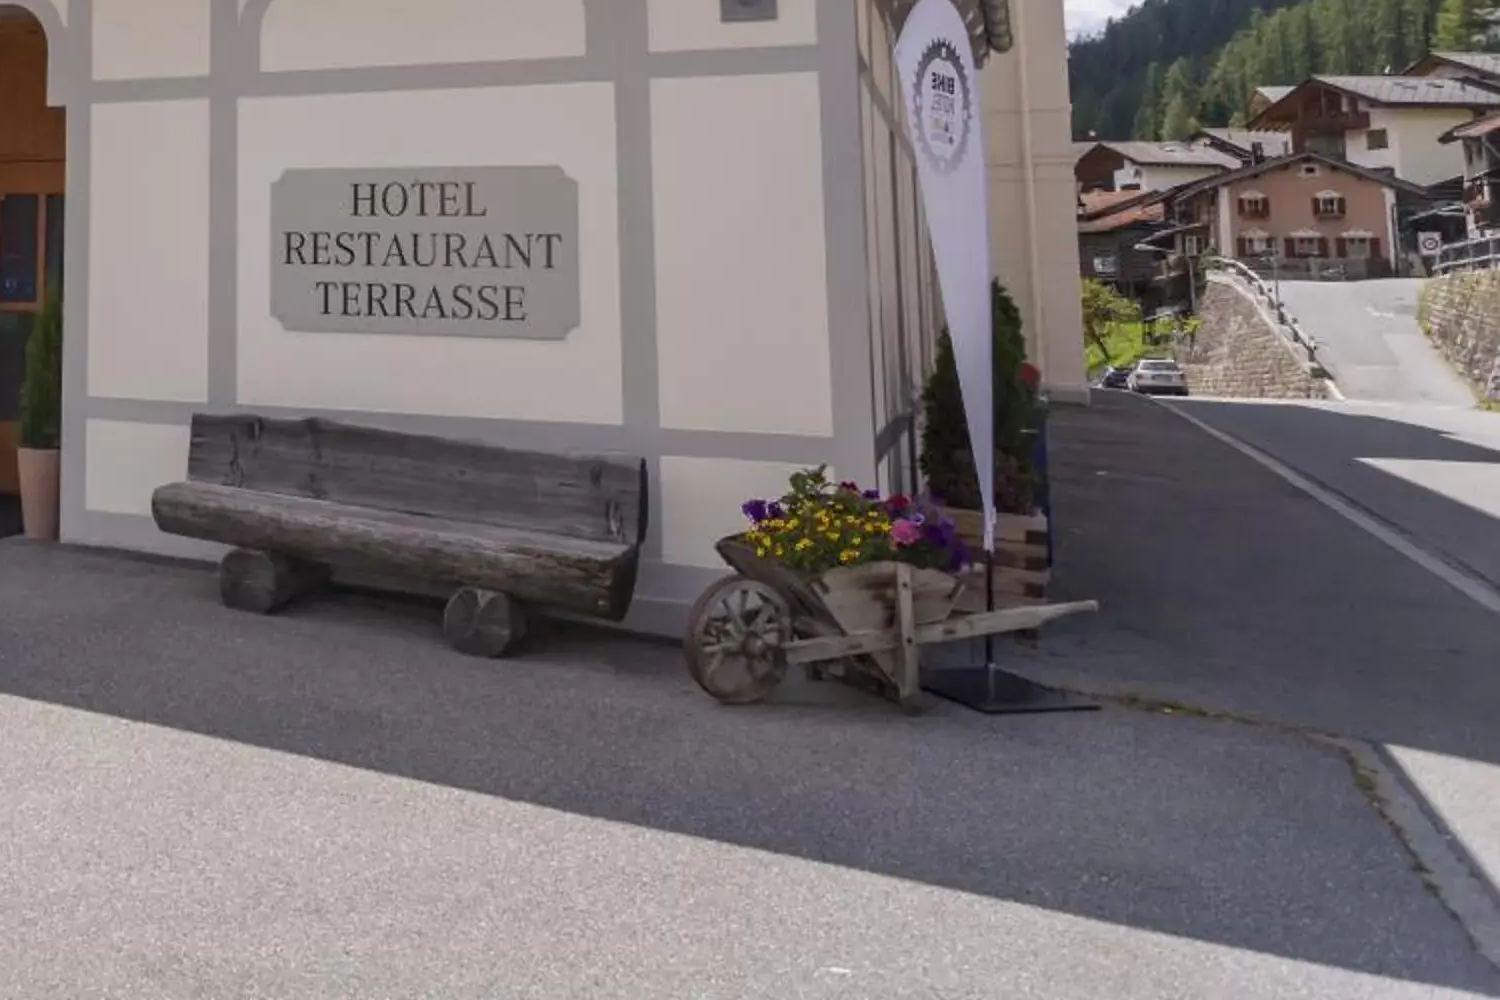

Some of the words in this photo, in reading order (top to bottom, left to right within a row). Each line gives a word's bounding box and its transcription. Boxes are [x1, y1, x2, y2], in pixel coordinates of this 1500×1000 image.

[350, 181, 487, 218] HOTEL
[282, 231, 563, 269] RESTAURANT
[315, 281, 527, 321] TERRASSE
